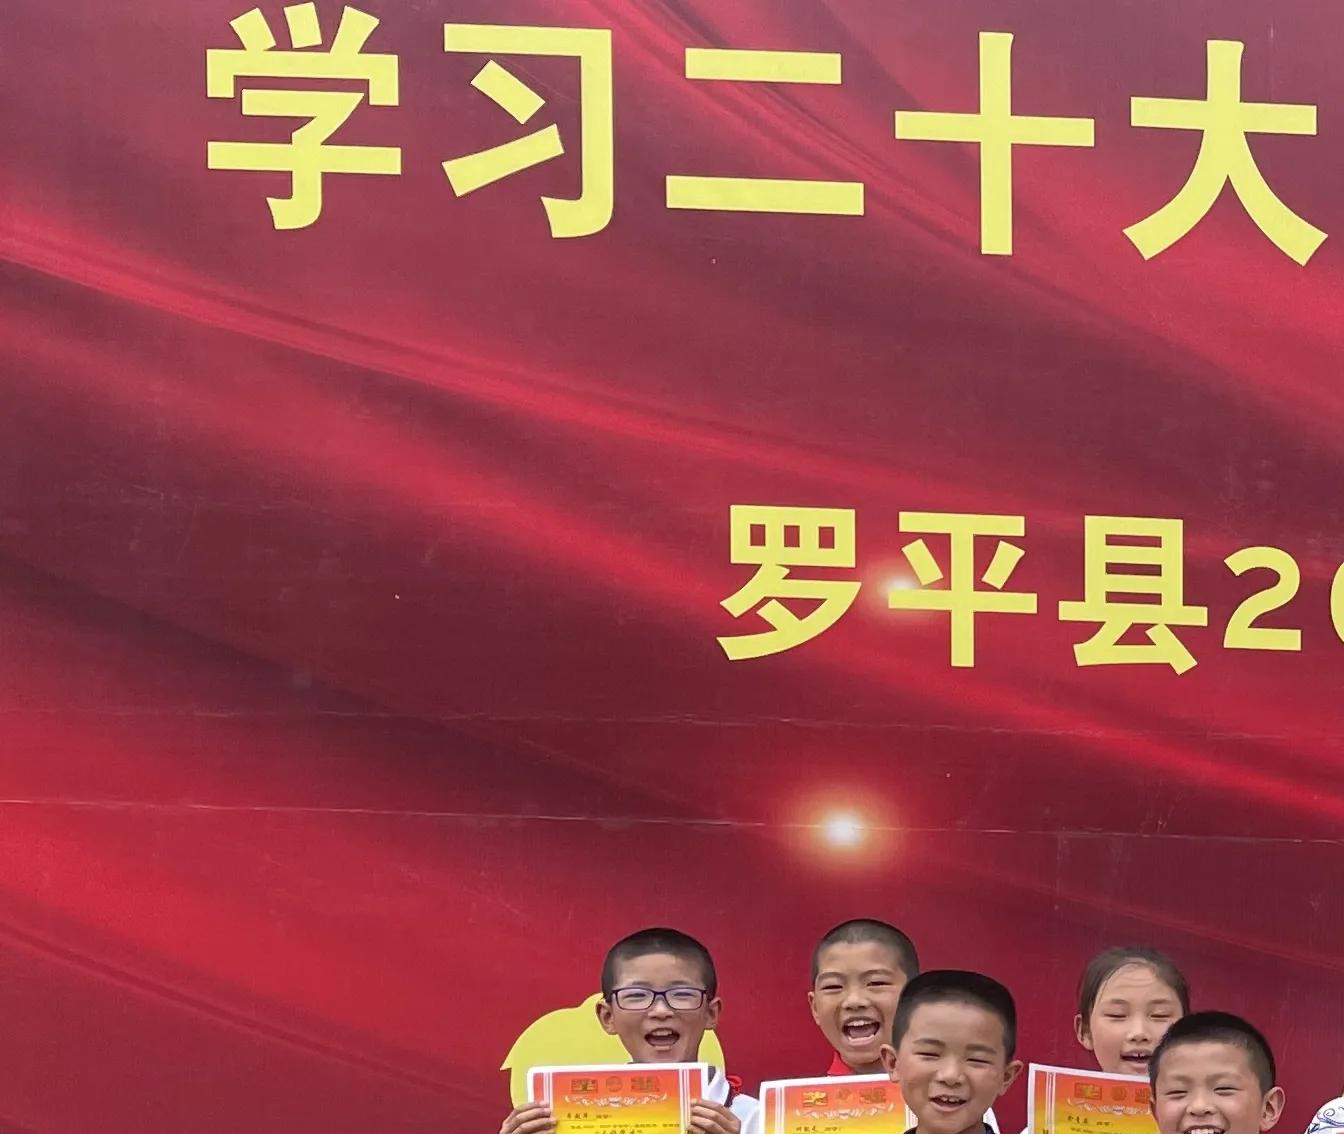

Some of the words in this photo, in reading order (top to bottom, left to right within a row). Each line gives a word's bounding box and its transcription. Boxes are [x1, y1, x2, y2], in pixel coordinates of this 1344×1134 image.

[206, 5, 1326, 265] 学习二十大
